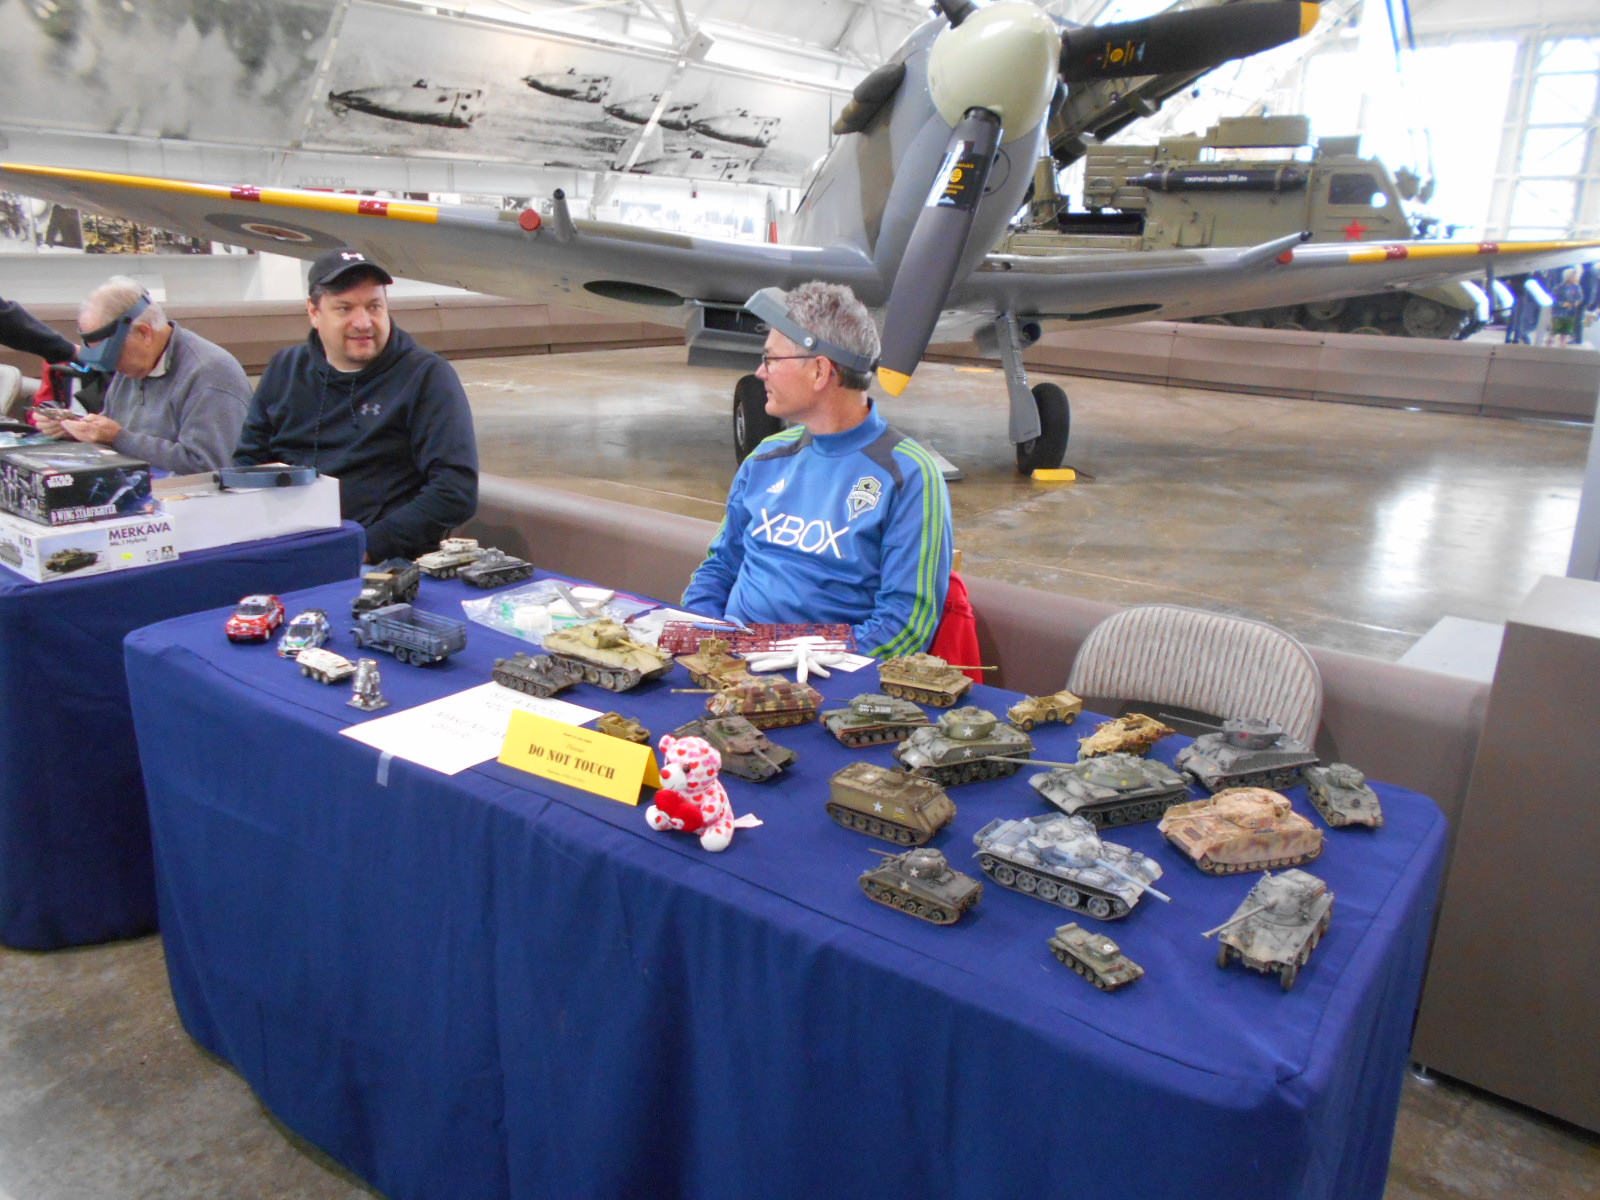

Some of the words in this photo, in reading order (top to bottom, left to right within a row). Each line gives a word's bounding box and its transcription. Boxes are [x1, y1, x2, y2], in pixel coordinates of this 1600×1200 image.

[109, 522, 171, 540] MERKAVA
[752, 508, 849, 559] XBOX
[528, 743, 545, 757] DO
[547, 748, 572, 766] NOT
[574, 756, 615, 780] TOUCH
